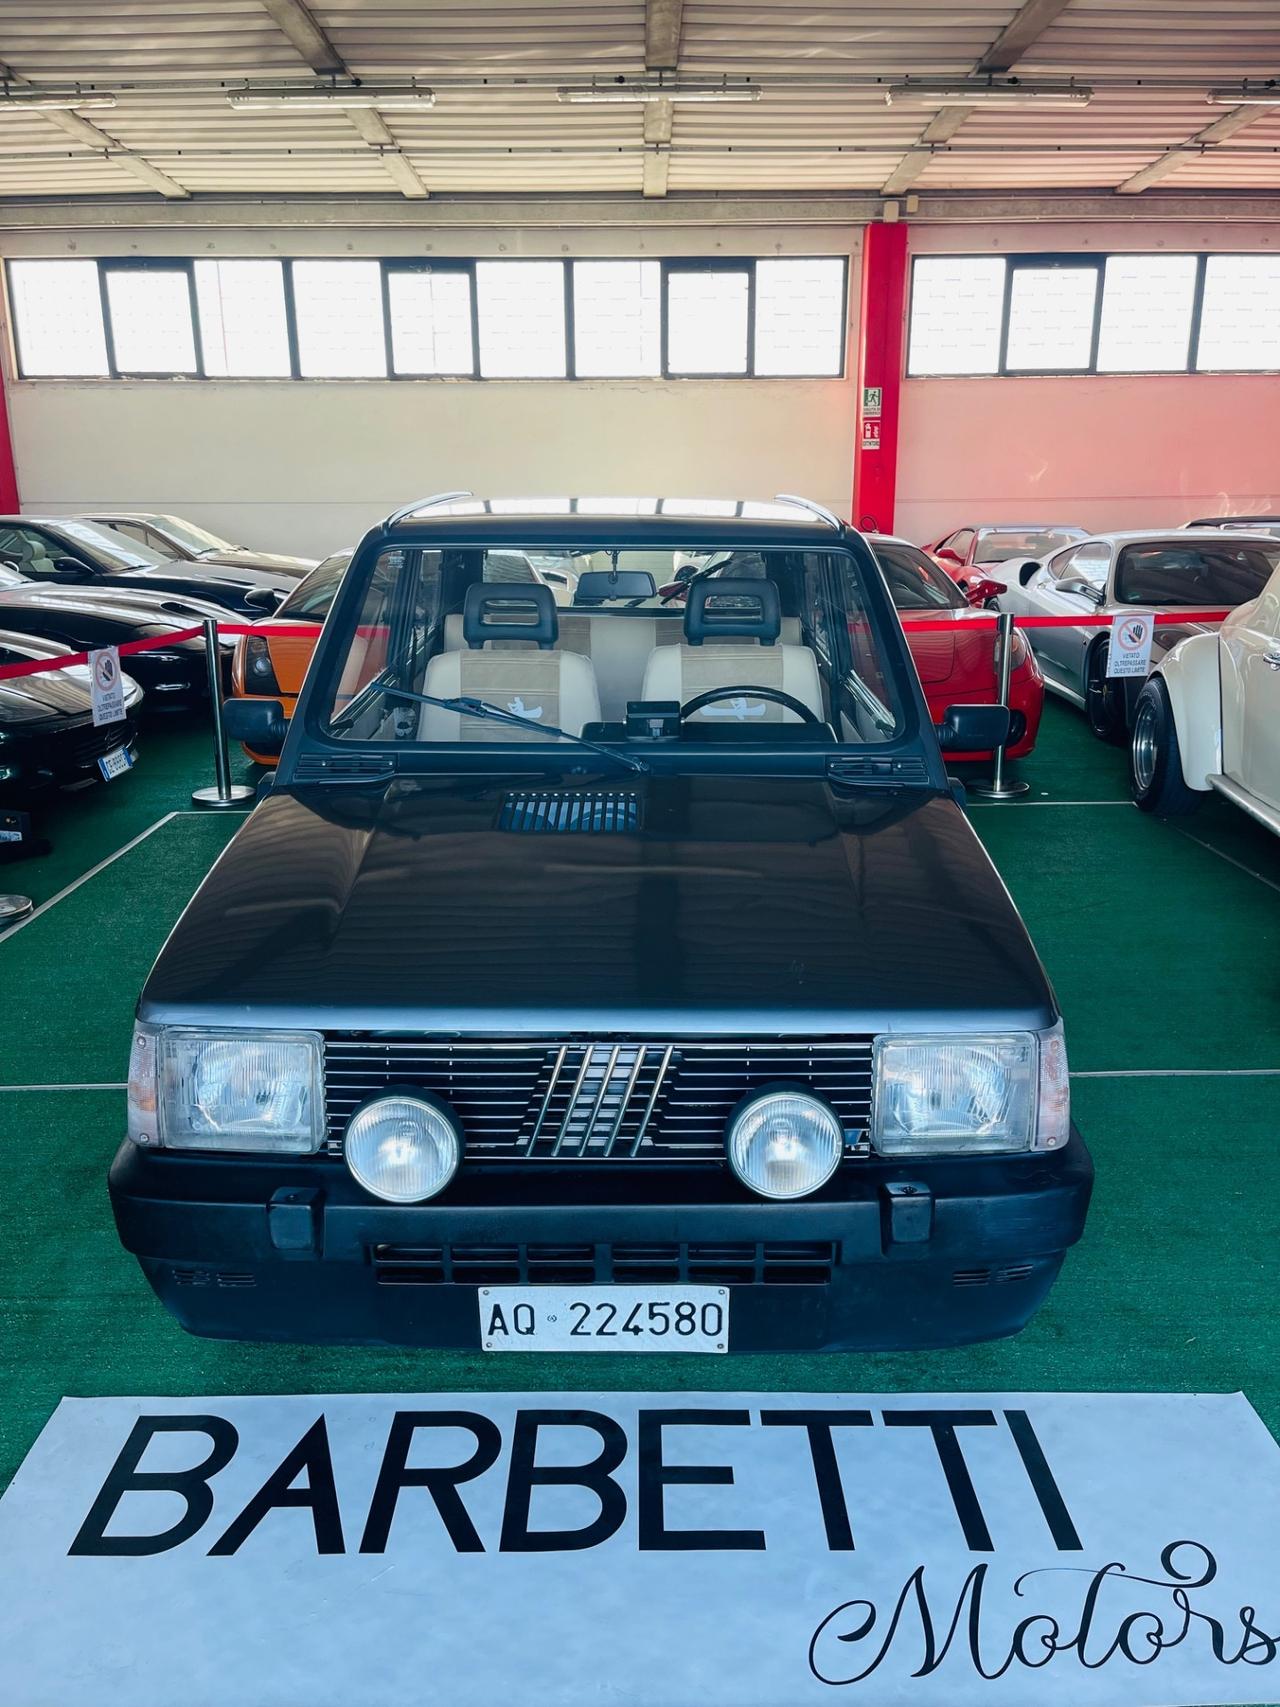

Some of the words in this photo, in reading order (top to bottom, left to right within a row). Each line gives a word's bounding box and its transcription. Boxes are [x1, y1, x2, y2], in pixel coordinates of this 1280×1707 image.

[487, 1303, 535, 1336] AQ
[569, 1302, 723, 1336] 224580
[66, 1409, 1084, 1557] BARBETTI
[808, 1540, 1280, 1686] Motors
